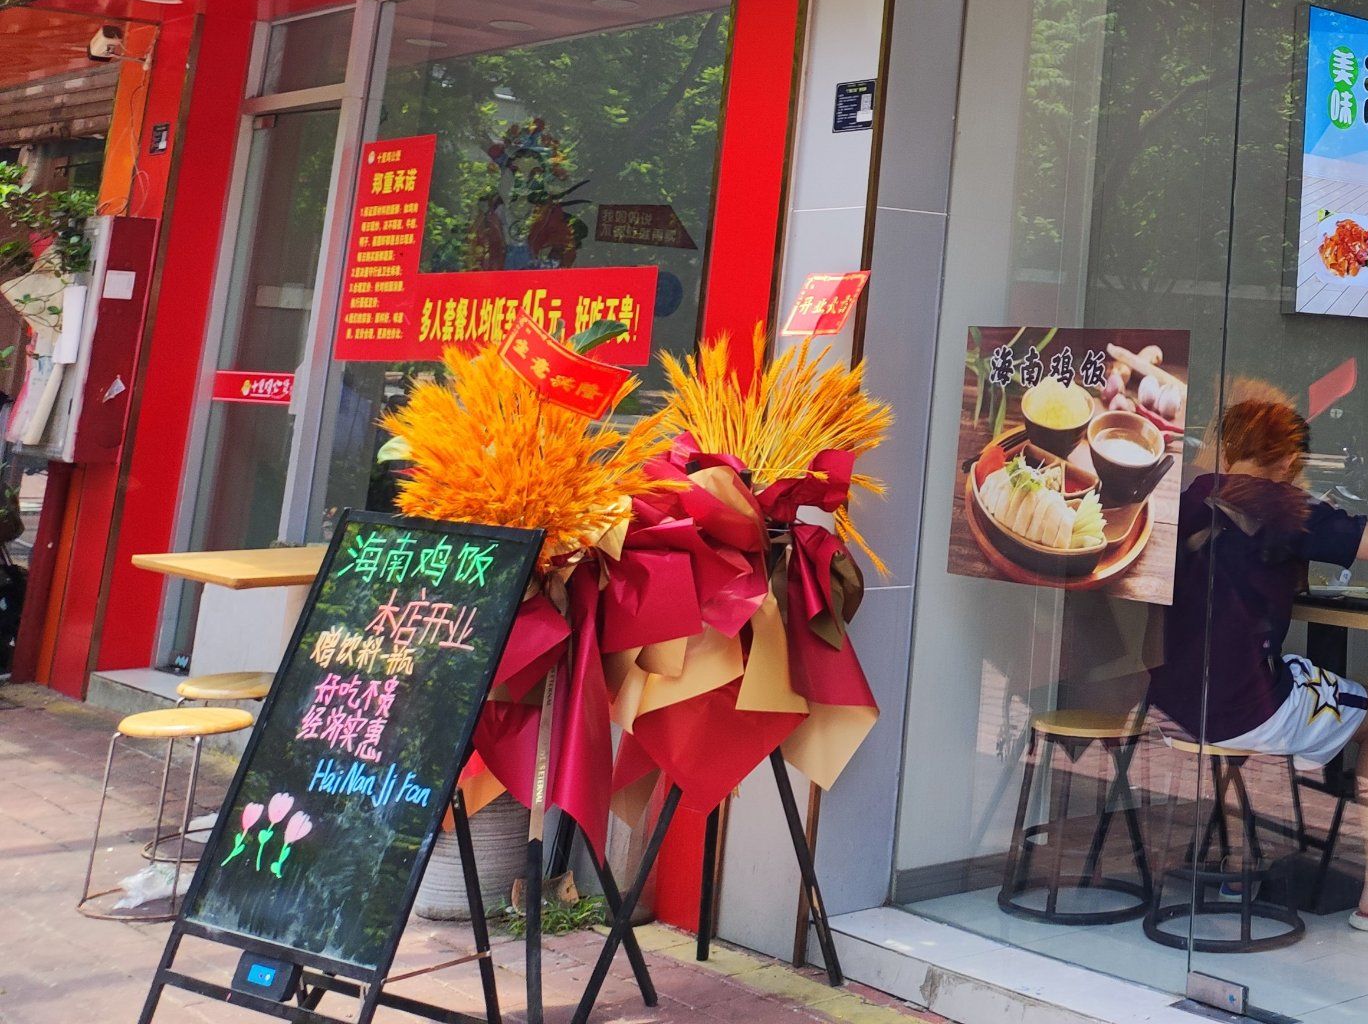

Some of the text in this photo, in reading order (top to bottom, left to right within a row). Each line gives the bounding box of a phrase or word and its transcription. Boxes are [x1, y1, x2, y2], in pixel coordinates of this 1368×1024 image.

[1329, 49, 1357, 126] 美味
[371, 168, 418, 195] 郑重承诺
[988, 345, 1109, 389] 海南鸡饭
[338, 532, 499, 588] 海南鸡饭
[365, 588, 476, 651] 本店开业
[310, 625, 414, 677] 赠饮料一瓶
[313, 672, 399, 718] 好吃不贵
[296, 704, 389, 762] 经济实惠
[397, 771, 432, 809] Fan
